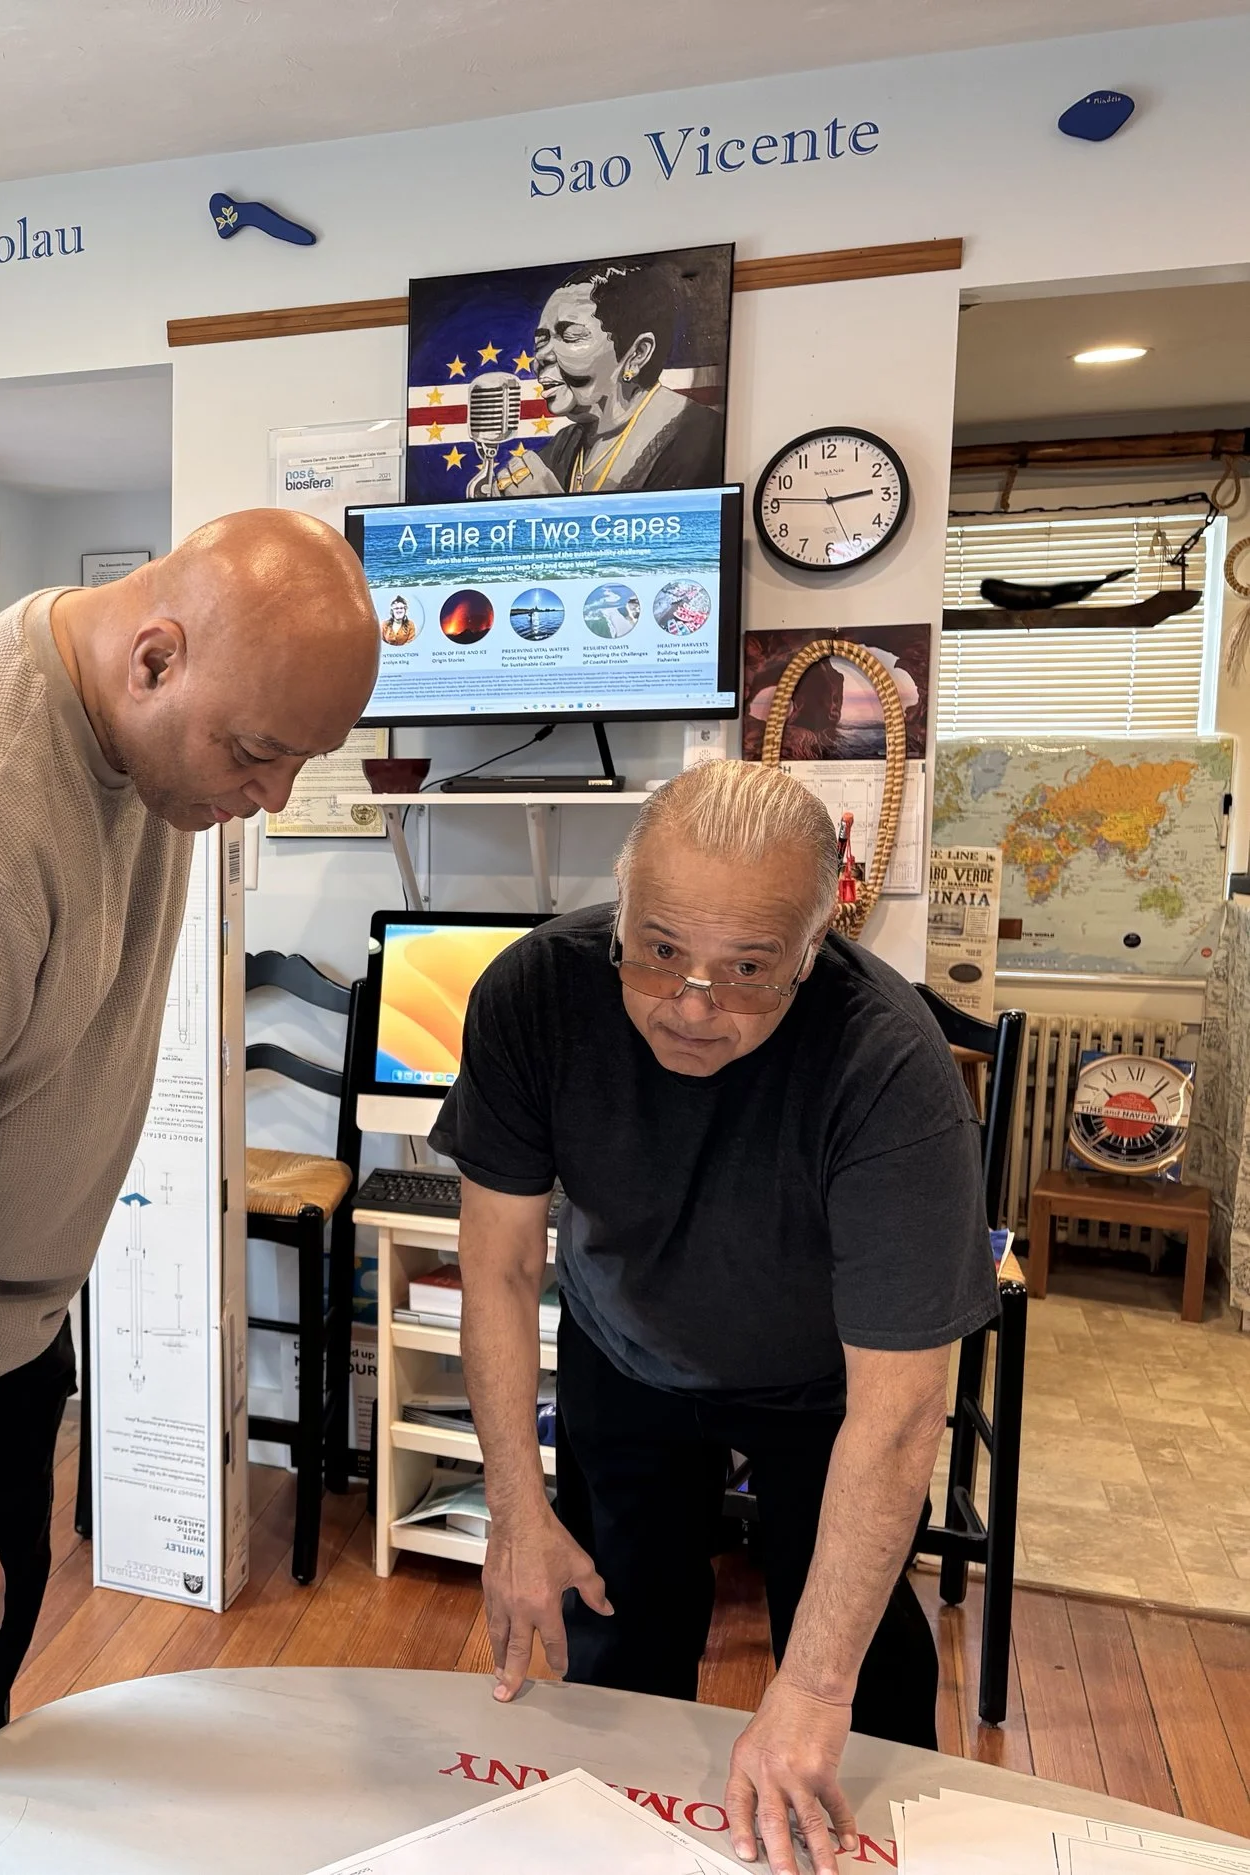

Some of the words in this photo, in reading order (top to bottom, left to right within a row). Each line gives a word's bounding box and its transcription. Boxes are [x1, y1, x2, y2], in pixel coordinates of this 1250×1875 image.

[531, 146, 631, 198] Sao
[644, 117, 880, 180] Vicente
[822, 444, 837, 460] 12
[855, 447, 858, 462] 1
[799, 454, 808, 469] 11
[285, 470, 306, 480] nos
[871, 462, 883, 478] 2
[285, 477, 334, 491] biosfera!
[778, 475, 793, 490] 10
[881, 487, 892, 501] 3
[770, 499, 780, 514] 9
[872, 513, 882, 528] 4
[397, 525, 418, 548] A
[425, 522, 480, 546] Tale
[490, 519, 517, 543] of
[525, 518, 580, 541] Two
[591, 514, 681, 541] Capes
[779, 523, 789, 538] 8
[799, 538, 809, 553] 7
[852, 533, 862, 547] 5
[426, 557, 450, 565] Explore
[486, 554, 521, 562] ecosystems
[574, 549, 617, 558] sustainability
[617, 548, 651, 556] challenges
[825, 542, 835, 557] 6
[558, 561, 574, 569] Cape
[948, 851, 979, 861] LINE
[953, 867, 994, 884] VERDE
[1081, 1106, 1102, 1115] TIME
[170, 1135, 203, 1143] PRODUCT
[361, 1350, 375, 1360] up
[154, 1514, 171, 1523] POST
[173, 1518, 205, 1529] MAILBOX
[177, 1526, 205, 1536] PLASTIC
[183, 1534, 205, 1543] WHITE
[165, 1542, 205, 1557] WHITLEY
[106, 1564, 180, 1586] ARCHITECTURAL
